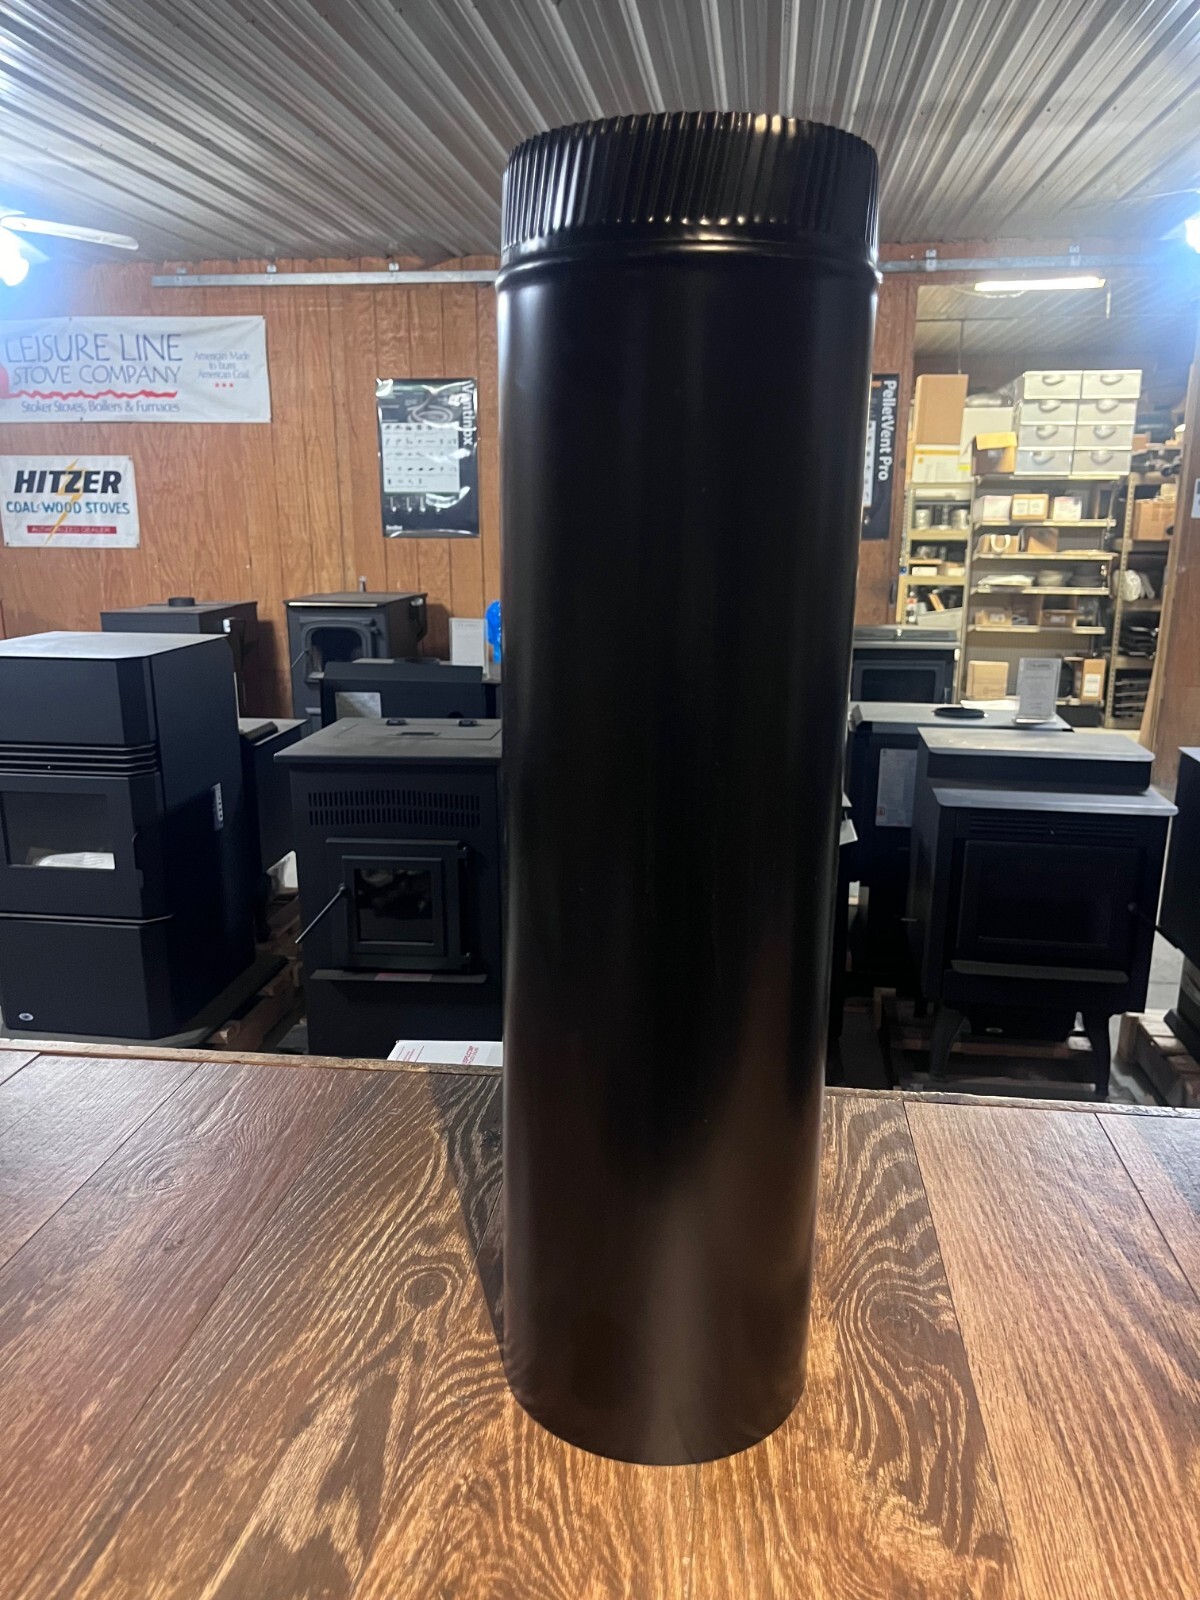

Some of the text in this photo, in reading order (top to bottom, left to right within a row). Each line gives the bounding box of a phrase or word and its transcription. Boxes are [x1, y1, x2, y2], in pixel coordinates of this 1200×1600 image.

[5, 333, 183, 363] LEISURE LINE
[13, 365, 181, 386] STOVE COMPANY
[125, 401, 134, 413] &
[136, 401, 180, 413] Furnaces
[877, 380, 897, 481] PelletVent Pro
[14, 470, 122, 493] HITZER
[85, 502, 130, 514] STOVES
